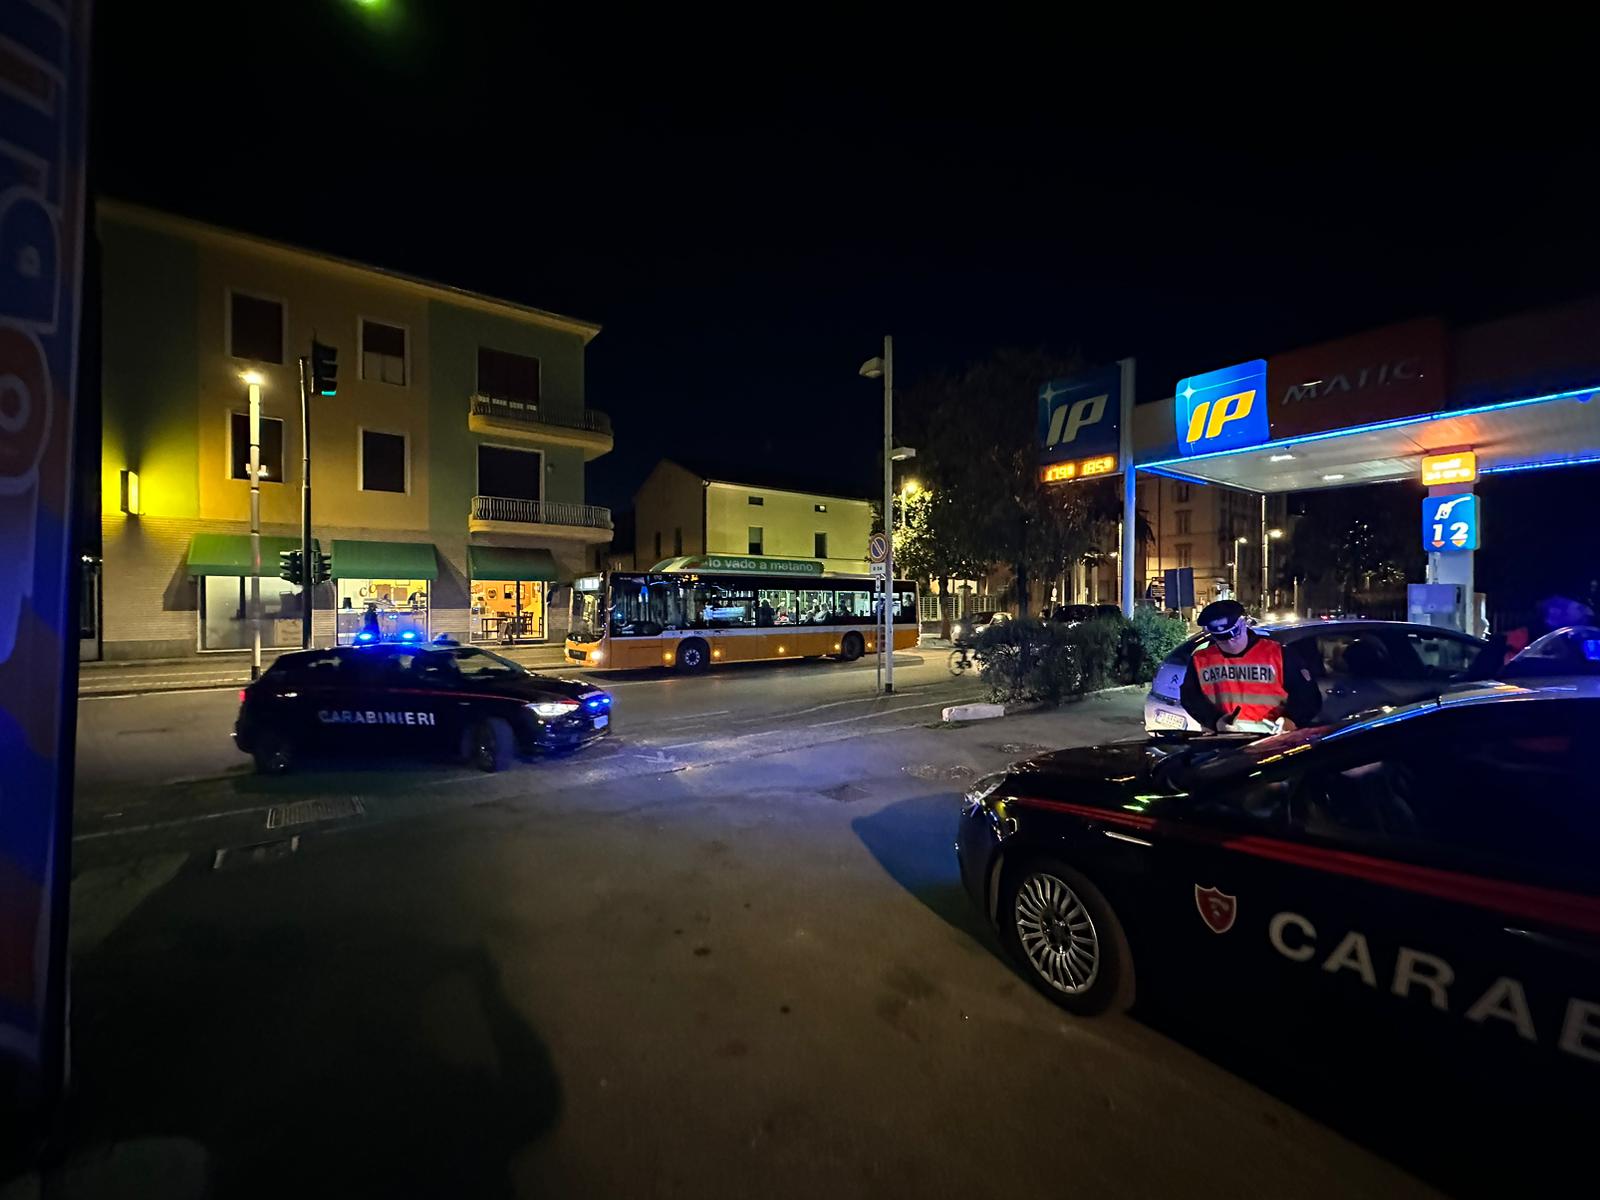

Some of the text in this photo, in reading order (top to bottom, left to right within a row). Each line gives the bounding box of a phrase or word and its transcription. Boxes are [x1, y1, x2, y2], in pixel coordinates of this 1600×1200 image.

[1047, 393, 1109, 446] IP
[1186, 390, 1256, 443] IP
[1432, 521, 1468, 541] 1 2
[724, 558, 756, 570] vado
[759, 560, 768, 570] a
[770, 561, 814, 573] metano
[1202, 666, 1272, 682] CARABINIERI
[317, 709, 436, 726] CARABINIERI
